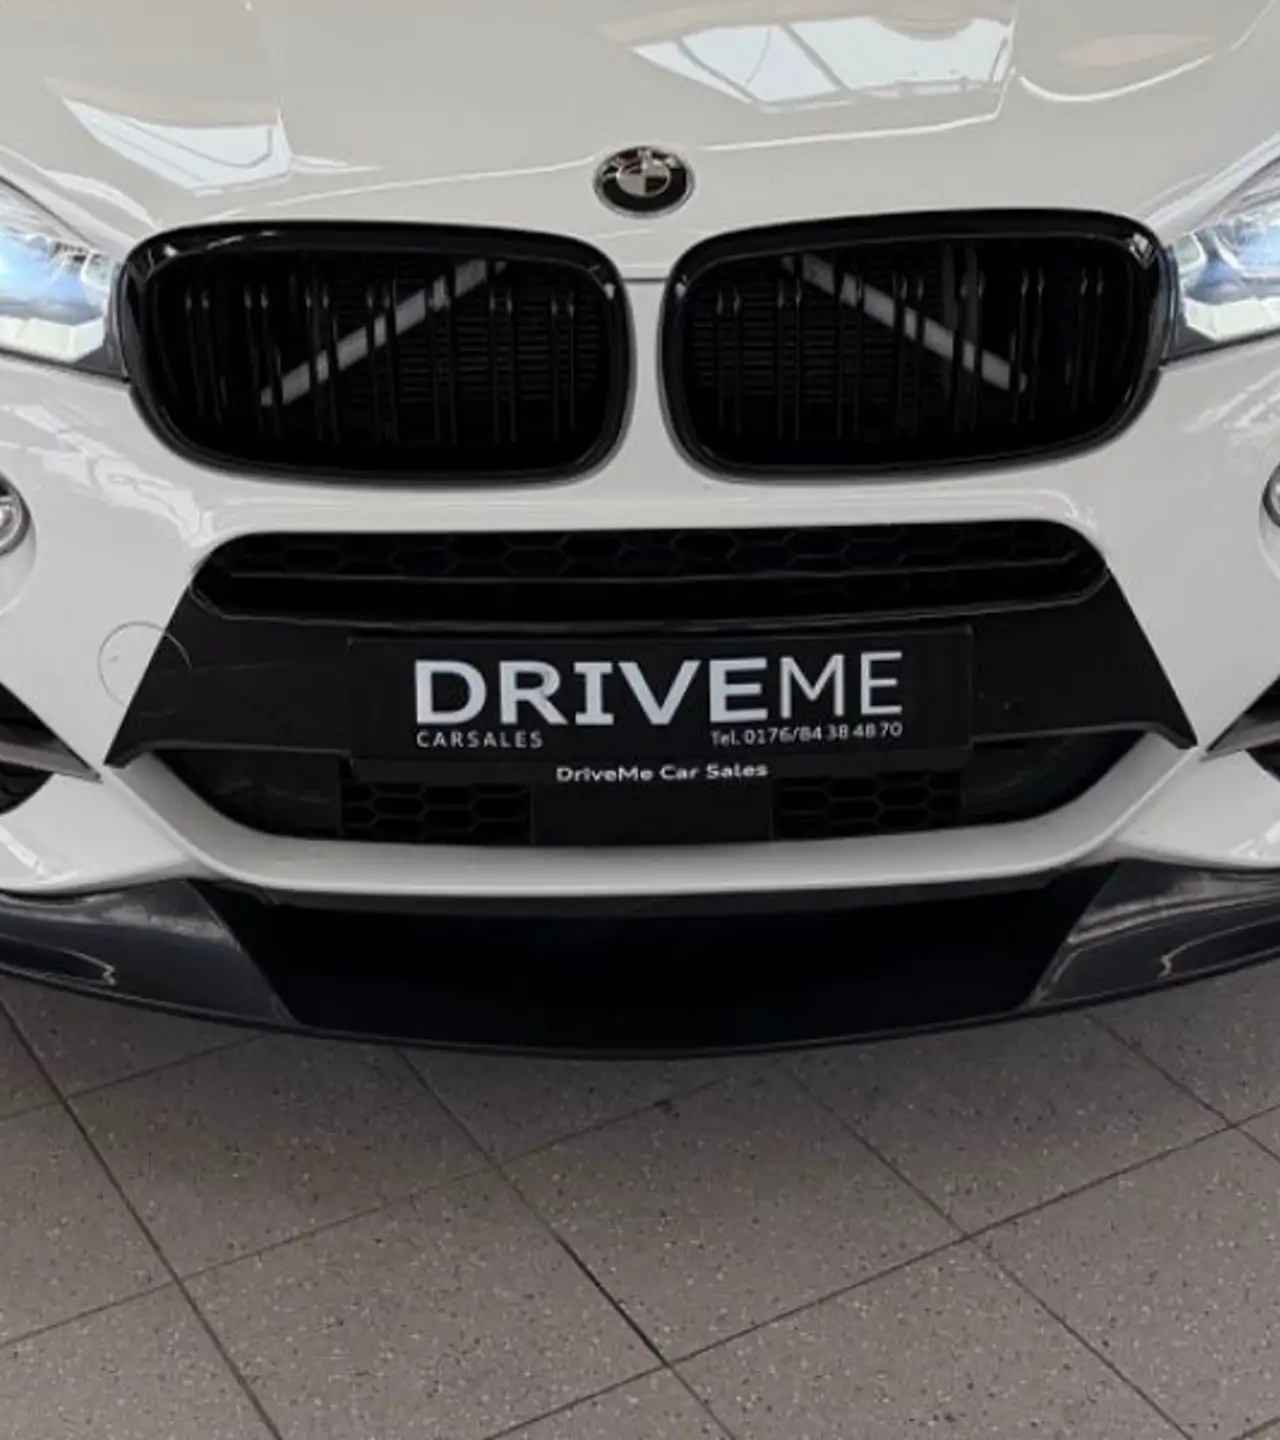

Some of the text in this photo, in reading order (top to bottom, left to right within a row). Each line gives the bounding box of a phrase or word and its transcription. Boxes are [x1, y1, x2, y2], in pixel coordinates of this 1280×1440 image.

[415, 651, 903, 726] DRIVEME
[416, 730, 543, 749] CARSALES
[556, 763, 769, 782] DriveMe Car Sales
